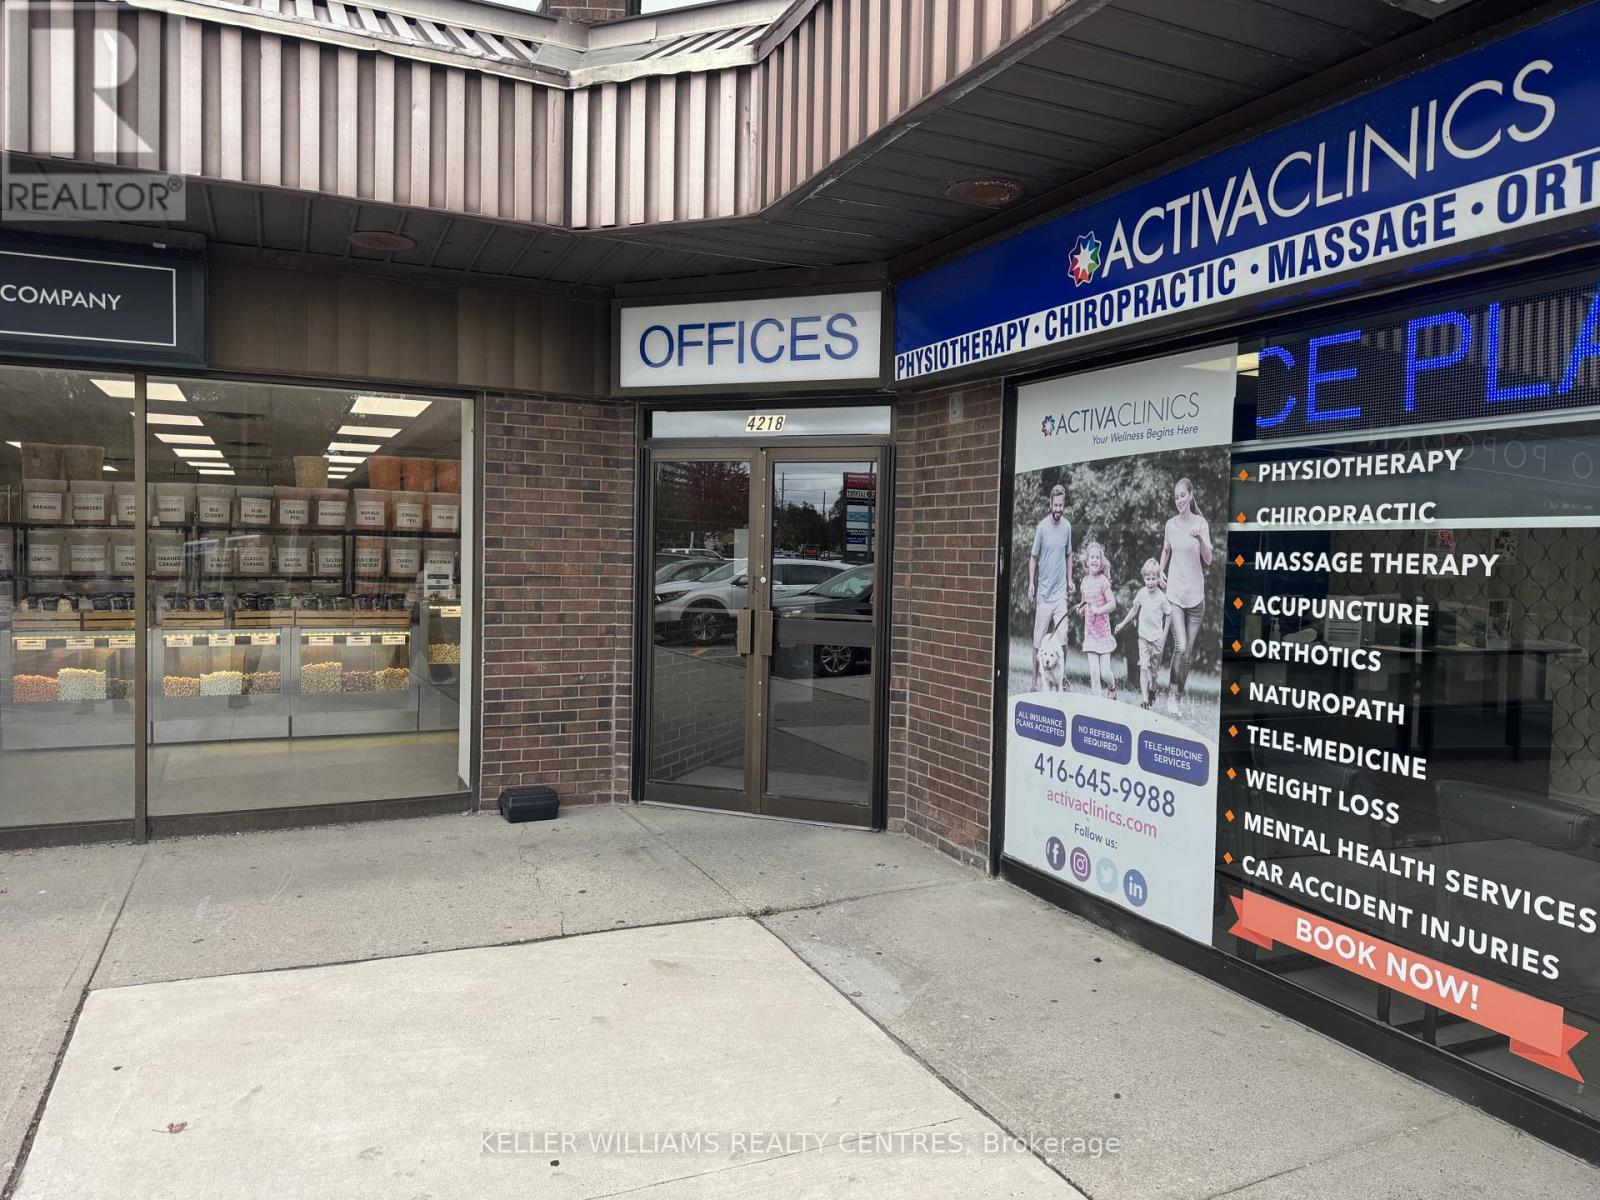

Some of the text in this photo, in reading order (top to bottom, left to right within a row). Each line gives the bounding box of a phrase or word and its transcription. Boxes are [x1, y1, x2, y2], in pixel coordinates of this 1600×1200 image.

[1102, 59, 1555, 278] ACTIVACLINICS
[0, 284, 122, 311] COMPANY
[897, 317, 1030, 380] PHYSIOTHERAPY
[1045, 258, 1236, 341] CHIROPRACTIC
[1268, 193, 1457, 284] MASSAGE
[639, 313, 859, 368] OFFICES
[747, 415, 784, 431] 4218
[1056, 392, 1200, 435] ACTIVACLINICS
[1092, 424, 1199, 445] Your Wellness Begins Here
[1258, 448, 1464, 482] PHYSIOTHERAPY
[1256, 502, 1437, 527] CHIROPRACTIC
[1254, 551, 1500, 577] MASSAGE THERAPY
[1252, 595, 1430, 626] ACUPUNCTURE
[1250, 638, 1382, 672] ORTHOTICS
[1018, 711, 1063, 728] ALL INSURANCE
[1248, 682, 1405, 725] NATUROPATH
[1016, 718, 1065, 737] PLANS ACCEPTED
[1078, 725, 1124, 743] NO REFERRAL
[1083, 736, 1118, 751] REQUIRED
[1144, 740, 1203, 762] TELE-MEDICINE
[1153, 753, 1191, 770] SERVICES
[1247, 725, 1427, 780] TELE-MEDICINE
[1034, 752, 1175, 817] 416-645-9988
[1245, 768, 1400, 825] WEIGHT LOSS
[1047, 788, 1157, 838] activaclinics.com
[1074, 823, 1118, 850] Follow us:
[1244, 812, 1598, 933] MENTAL HEALTH SERVICES
[1242, 855, 1560, 981] CAR ACCIDENT INJURIES
[1296, 918, 1480, 1011] BOOK NOW!
